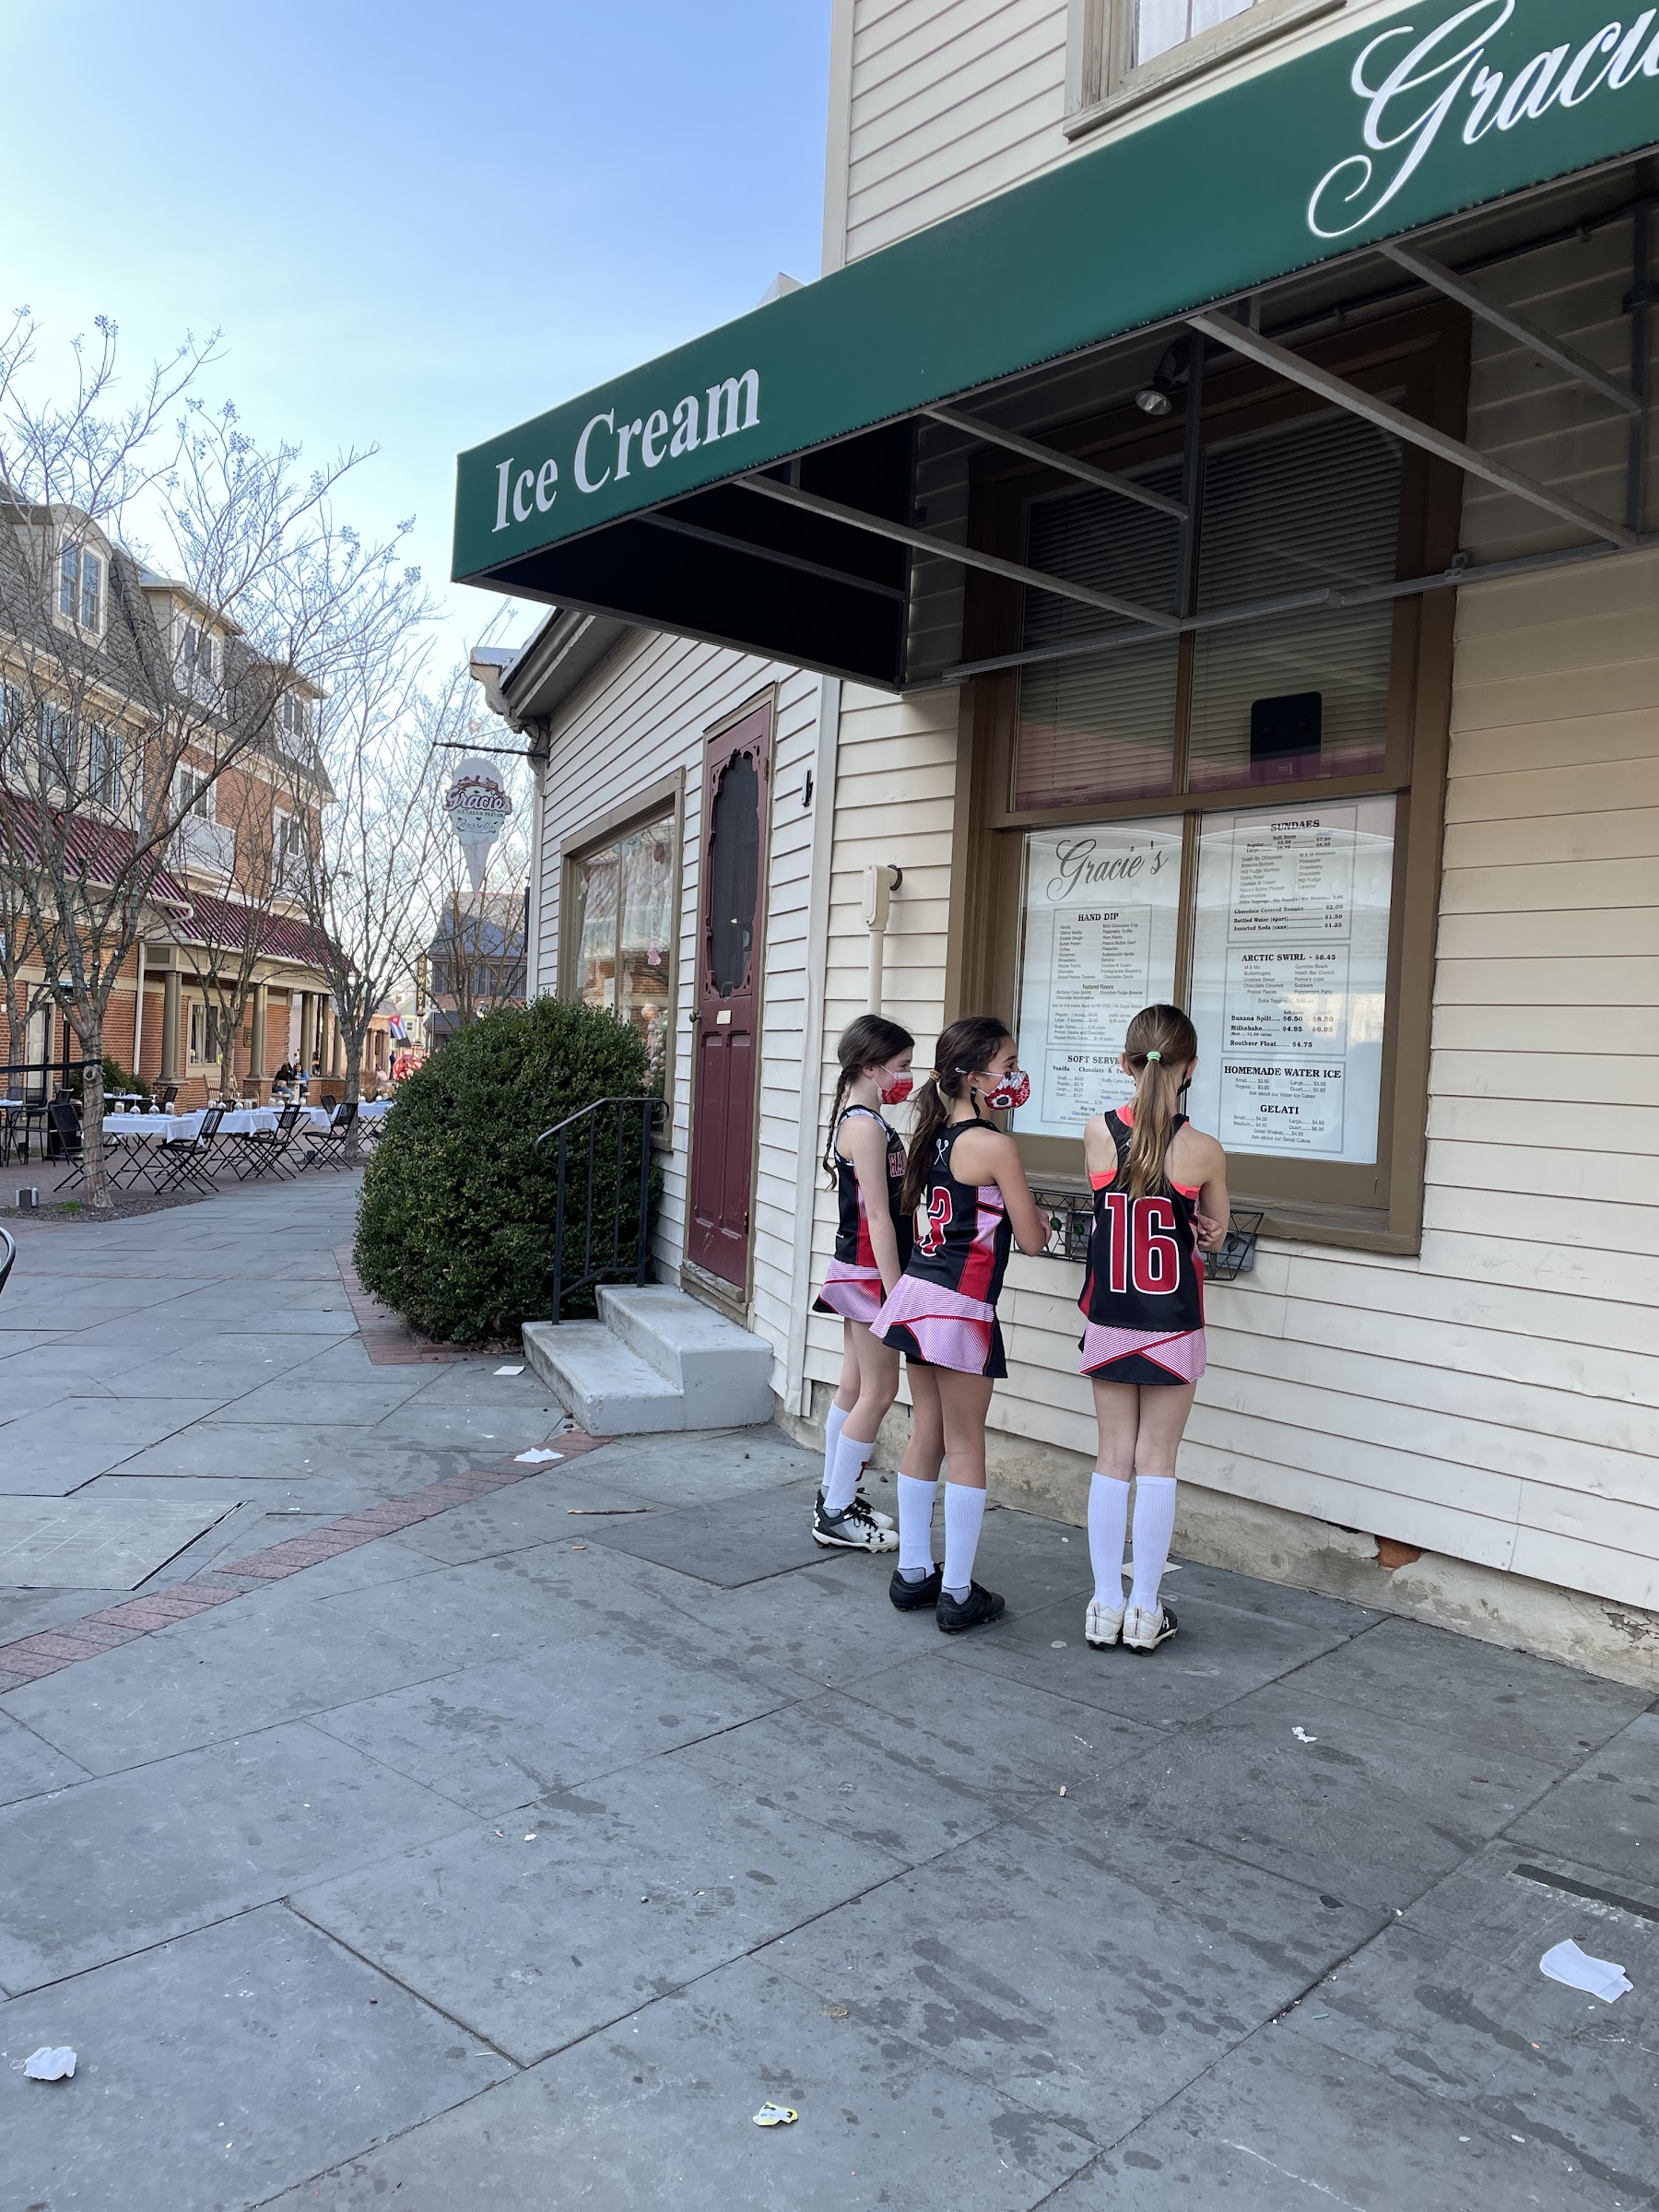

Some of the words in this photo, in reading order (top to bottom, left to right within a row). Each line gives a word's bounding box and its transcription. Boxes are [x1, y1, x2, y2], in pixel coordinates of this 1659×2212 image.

[1307, 0, 1659, 238] Graci
[492, 457, 559, 533] Ice
[573, 368, 760, 494] Cream
[1271, 819, 1320, 831] SUNDAES
[1047, 839, 1169, 901] Gracie's
[1078, 913, 1100, 922] HAND
[1225, 1066, 1281, 1076] HOMEMADE
[1285, 1068, 1320, 1077] WATER
[1260, 1105, 1299, 1114] GELATI
[1104, 1192, 1180, 1295] 16
